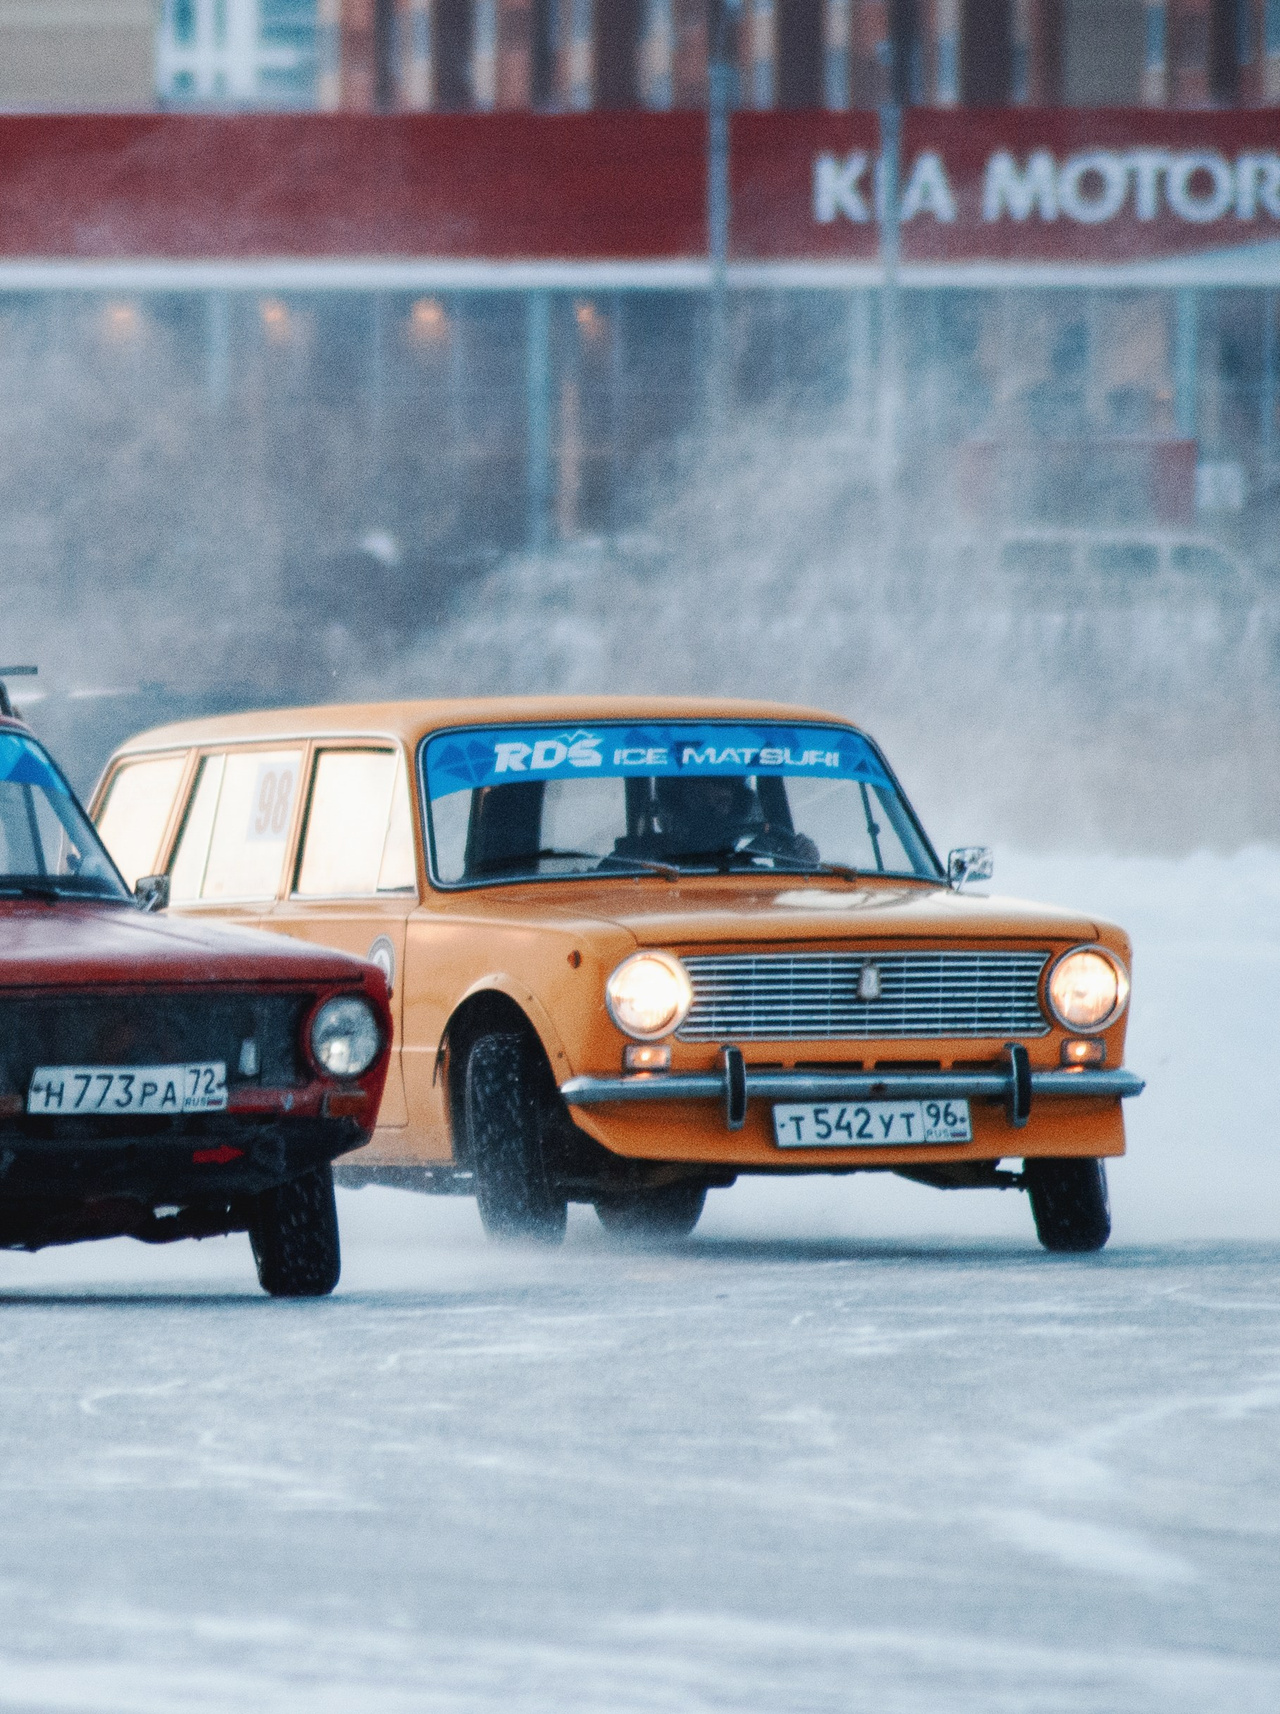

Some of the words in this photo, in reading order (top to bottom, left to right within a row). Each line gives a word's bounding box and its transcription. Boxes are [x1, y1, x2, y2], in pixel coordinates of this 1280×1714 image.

[813, 148, 958, 224] KA
[981, 147, 1280, 225] MOTOR
[493, 738, 603, 773] RDS
[613, 747, 669, 766] ICE
[681, 746, 840, 768] MATSURI
[253, 768, 293, 835] 98
[188, 1067, 216, 1096] 72
[925, 1102, 958, 1128] 96
